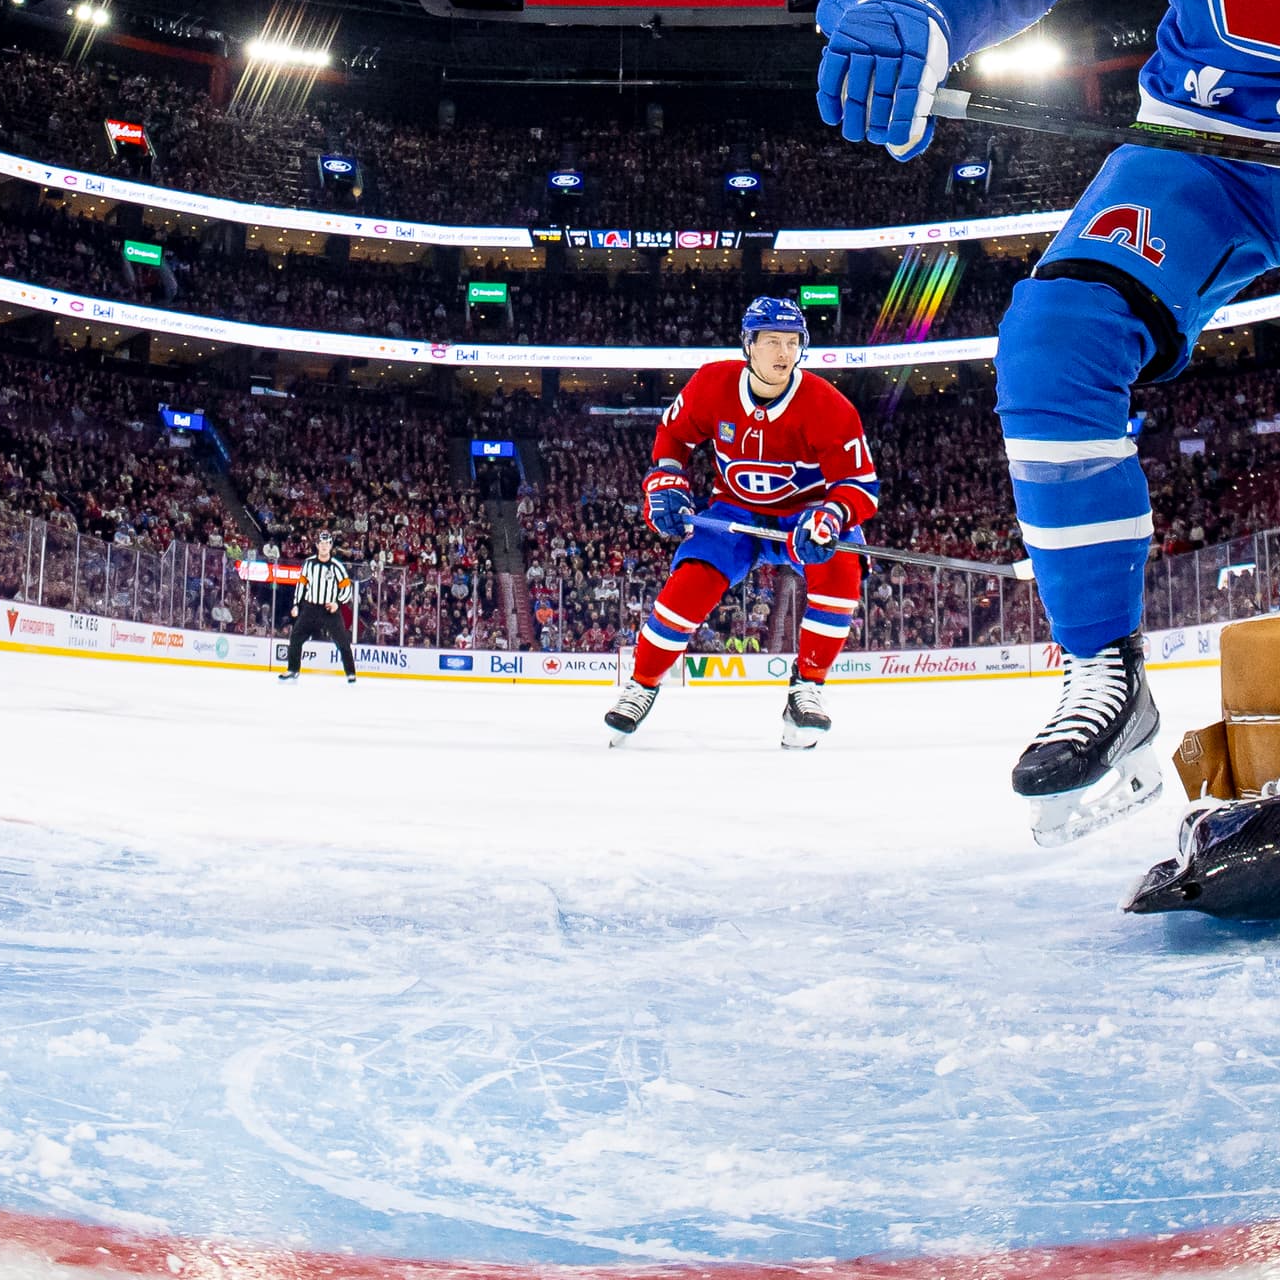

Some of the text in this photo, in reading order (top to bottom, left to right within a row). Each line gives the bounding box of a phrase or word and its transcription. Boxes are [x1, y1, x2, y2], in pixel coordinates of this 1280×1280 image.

[85, 178, 105, 193] Bell
[93, 304, 114, 319] Bell
[456, 350, 479, 361] Bell
[845, 353, 867, 364] Bell
[69, 614, 98, 631] THE KEG
[490, 655, 523, 674] Bell
[565, 660, 587, 670] AIR
[880, 653, 977, 675] Tim Hortons
